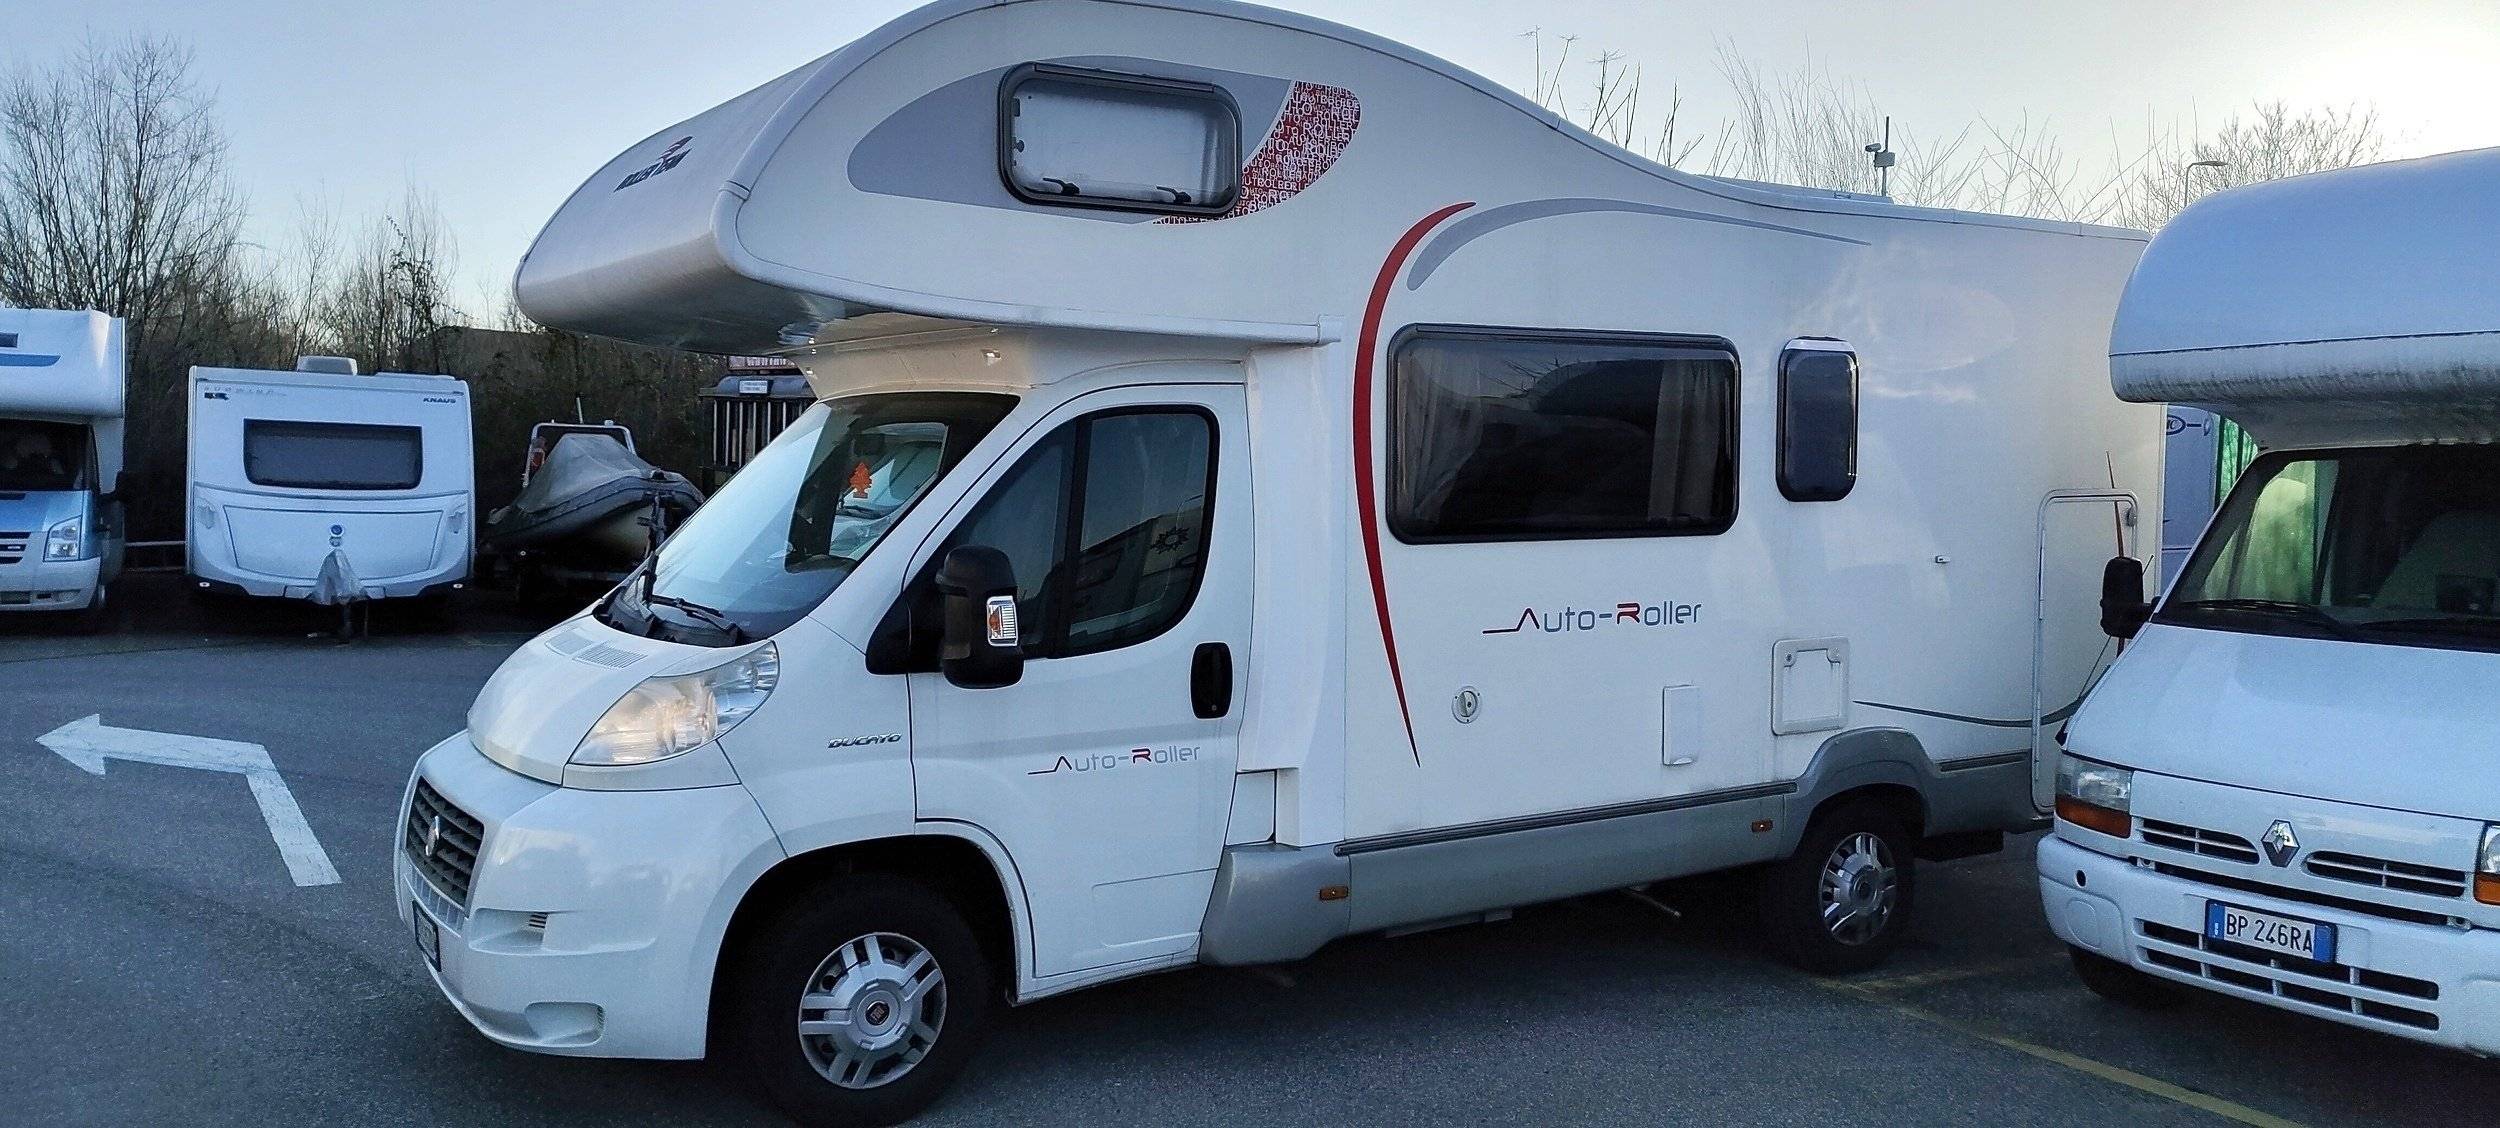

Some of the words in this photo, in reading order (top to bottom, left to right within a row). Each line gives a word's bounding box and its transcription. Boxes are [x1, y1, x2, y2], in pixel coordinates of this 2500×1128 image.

[1482, 600, 1702, 635] Auto-Roller
[828, 733, 902, 749] DUCATO
[1027, 745, 1201, 775] Auto-Roller
[2226, 913, 2249, 937] BP
[2253, 919, 2313, 953] 246RA
